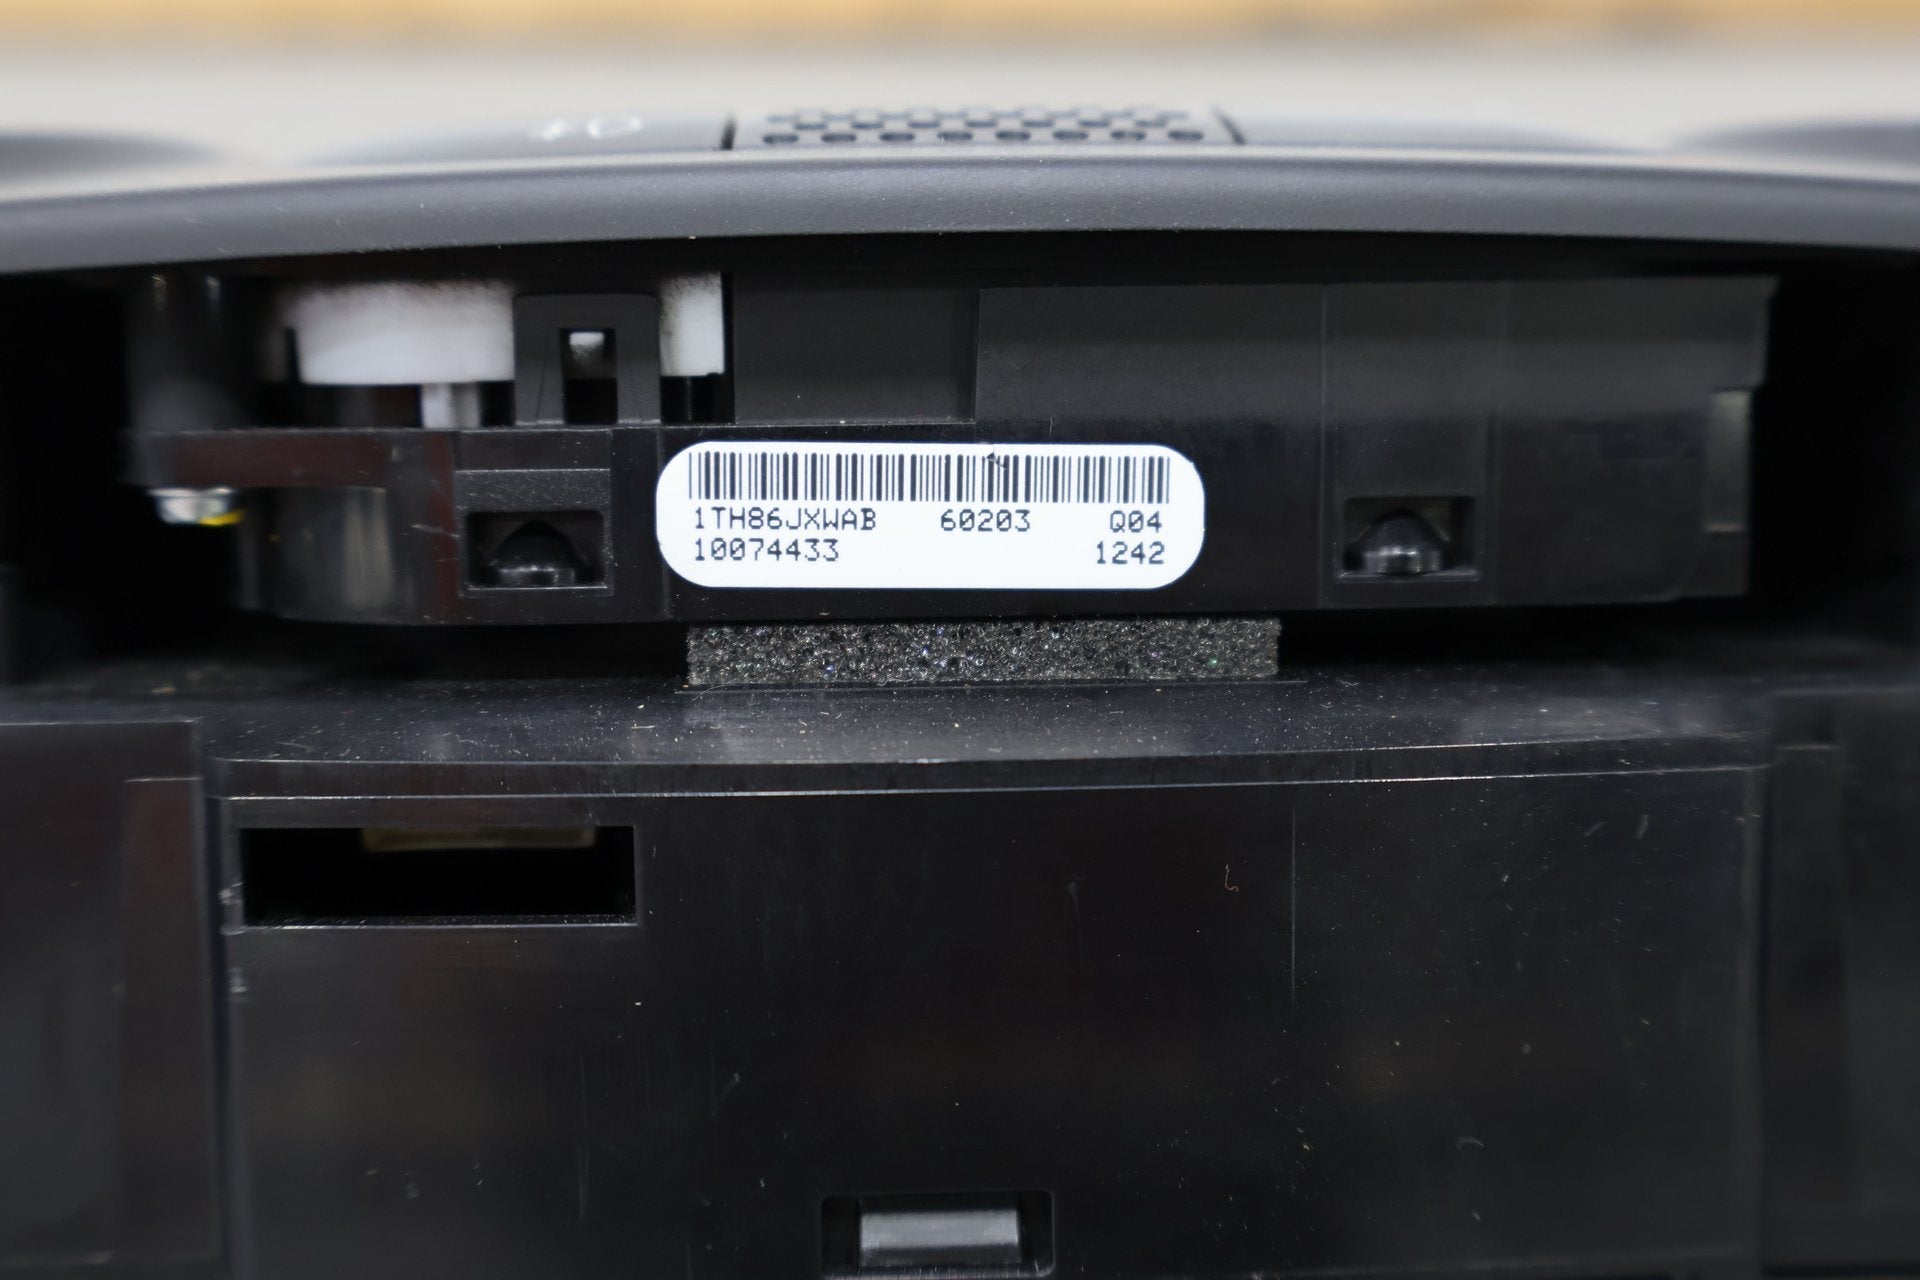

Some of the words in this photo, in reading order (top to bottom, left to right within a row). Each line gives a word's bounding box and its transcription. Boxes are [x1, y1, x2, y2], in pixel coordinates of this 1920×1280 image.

[695, 506, 876, 530] 1TH86JXWAB
[940, 508, 1031, 532] 60203
[1109, 510, 1162, 533] Q04
[695, 537, 839, 562] 10074433
[1096, 541, 1165, 565] 1242
